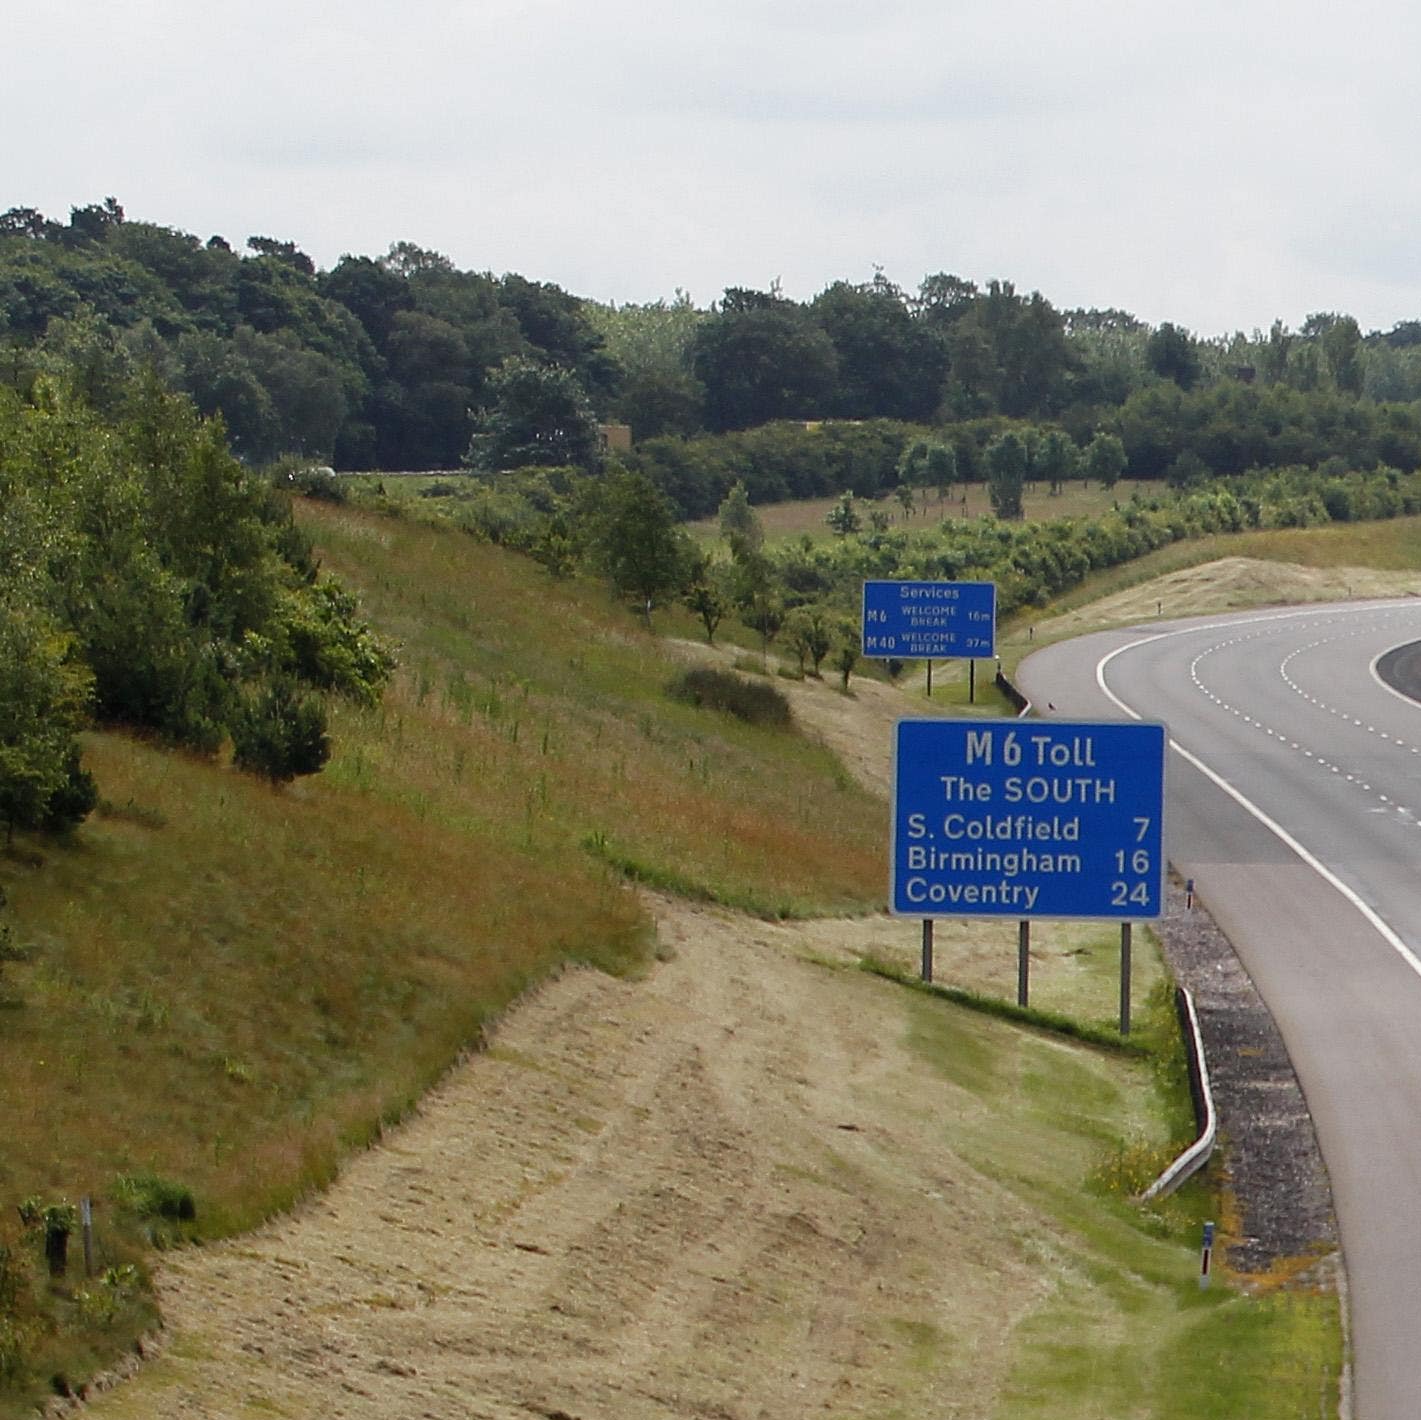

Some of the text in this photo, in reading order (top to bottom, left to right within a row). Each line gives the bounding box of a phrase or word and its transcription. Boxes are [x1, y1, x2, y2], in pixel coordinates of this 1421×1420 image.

[900, 586, 959, 599] Services
[902, 606, 956, 616] WELCOME
[911, 617, 946, 626] BREAK
[902, 633, 956, 643] WELCOME
[911, 644, 946, 653] BREAK
[1032, 736, 1095, 766] Toll
[941, 777, 1114, 802] The SOUTH
[908, 814, 1149, 841] S. Coldfield 7
[909, 846, 1149, 876] Birmingham 16
[907, 877, 1149, 908] Coventry 24
